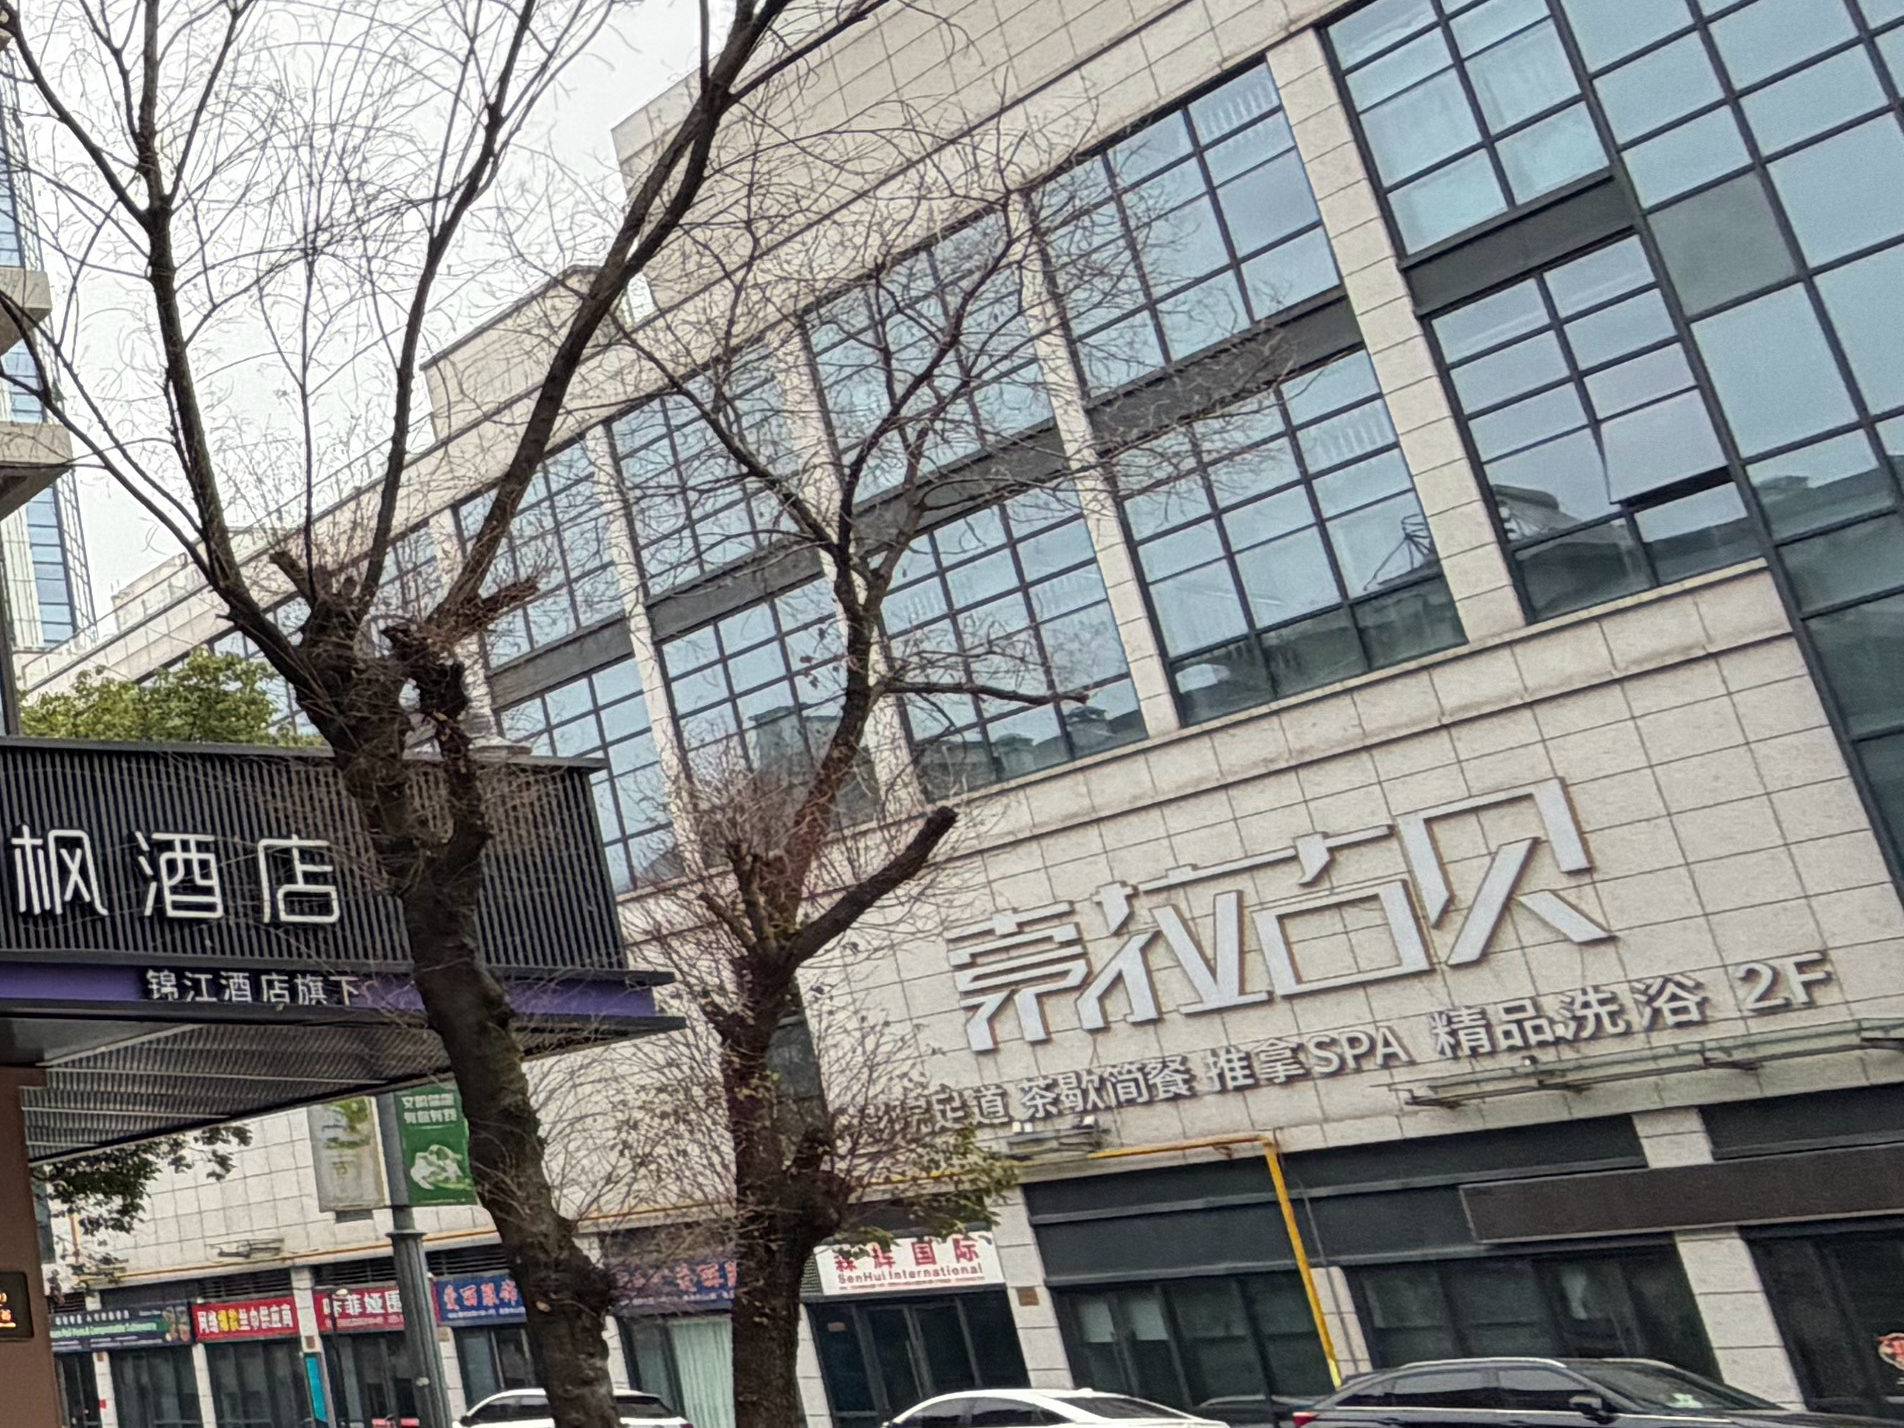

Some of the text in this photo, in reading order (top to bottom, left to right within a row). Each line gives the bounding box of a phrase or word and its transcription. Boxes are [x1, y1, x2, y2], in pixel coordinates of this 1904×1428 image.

[147, 970, 360, 1007] 锦江酒店旗下
[1020, 1056, 1192, 1118] 茶歇简餐
[1431, 975, 1705, 1058] 精品洗浴
[1735, 951, 1833, 1014] 2F
[888, 1263, 983, 1280] International
